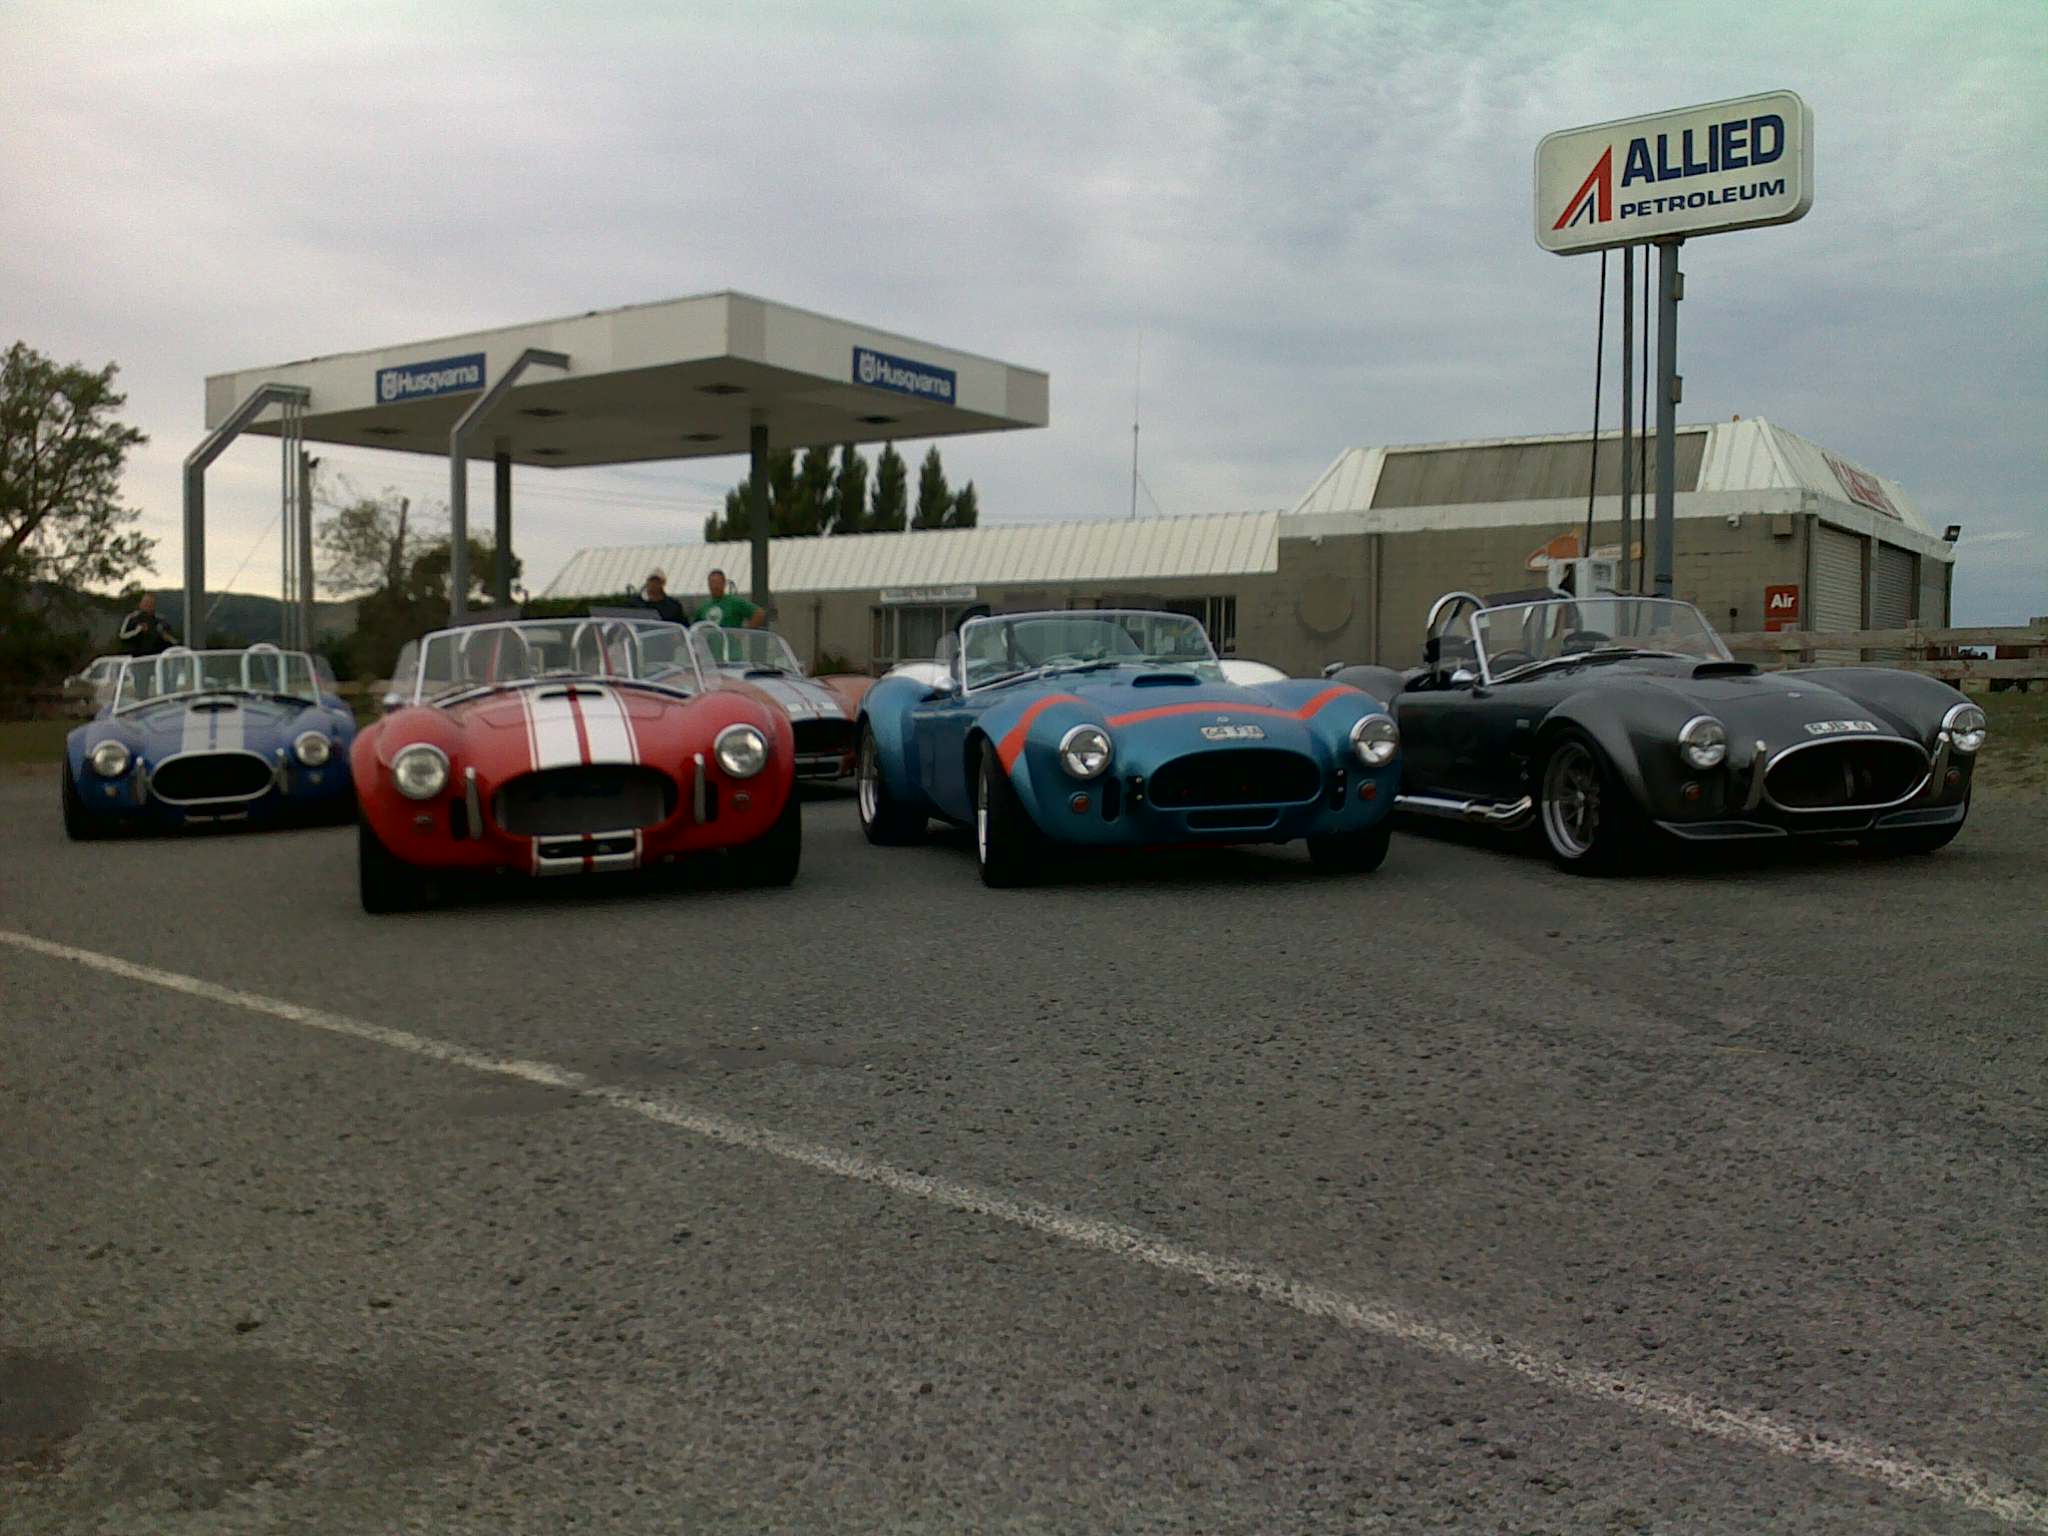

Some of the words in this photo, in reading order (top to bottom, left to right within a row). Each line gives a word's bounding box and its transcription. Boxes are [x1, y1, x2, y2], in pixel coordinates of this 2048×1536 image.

[1621, 114, 1785, 188] ALLIED
[1620, 179, 1785, 219] PETROLEUM
[1770, 593, 1795, 608] Air
